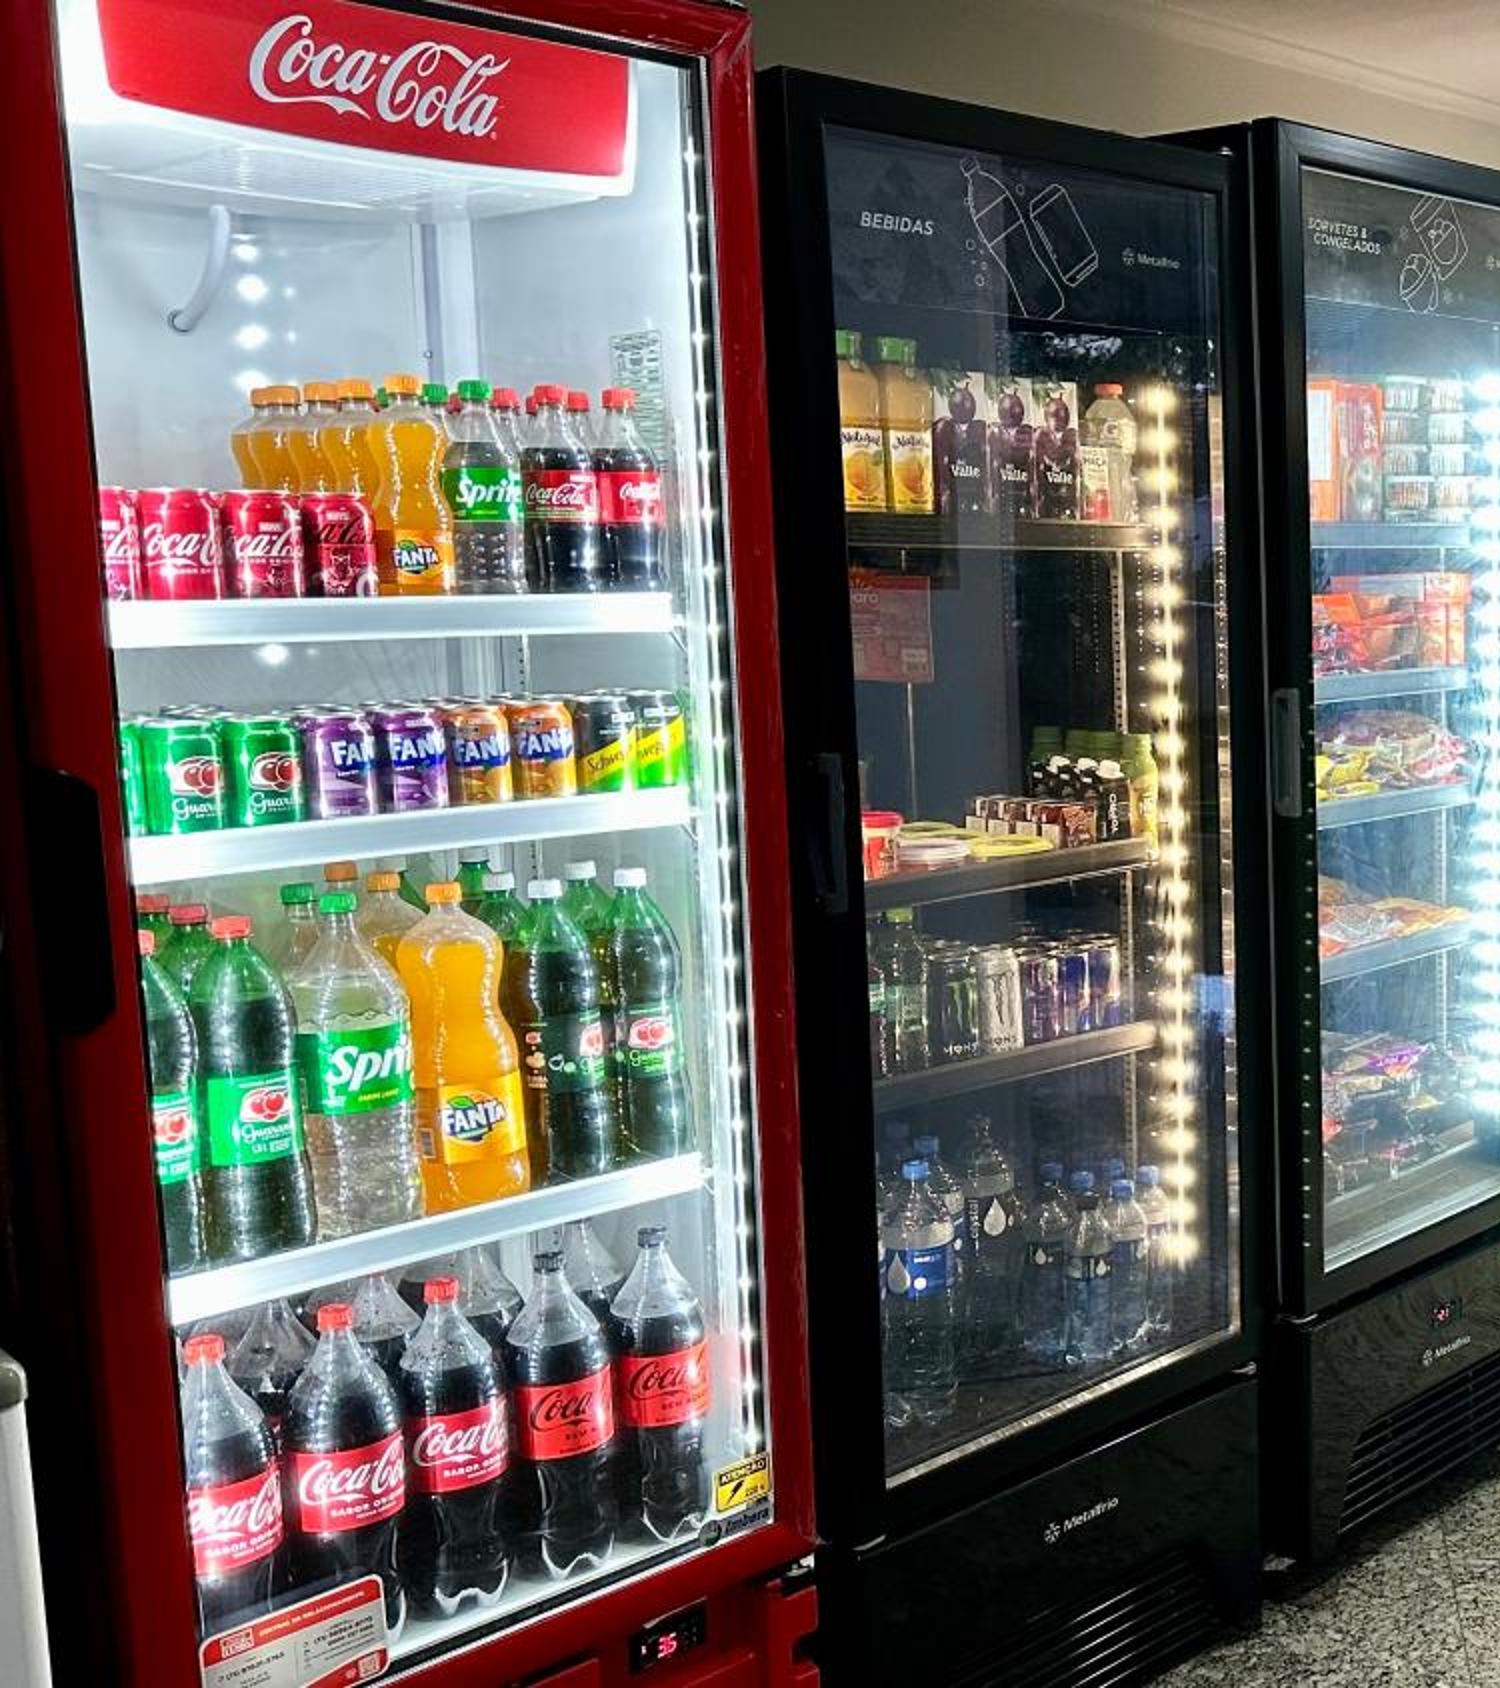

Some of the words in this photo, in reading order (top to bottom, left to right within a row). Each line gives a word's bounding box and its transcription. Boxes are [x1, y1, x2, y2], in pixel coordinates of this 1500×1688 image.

[249, 15, 510, 136] Coca-Cola
[859, 211, 934, 237] BEBIDAS
[1307, 217, 1359, 237] SORVETES
[1313, 232, 1381, 255] CONGELADOS
[951, 463, 980, 478] Valle
[1000, 467, 1028, 481] Valle
[1046, 471, 1073, 484] Valle
[393, 545, 439, 573] FANTA
[330, 734, 375, 767] FAN
[442, 1097, 507, 1133] FANTA
[1063, 1497, 1119, 1533] Metalfrio
